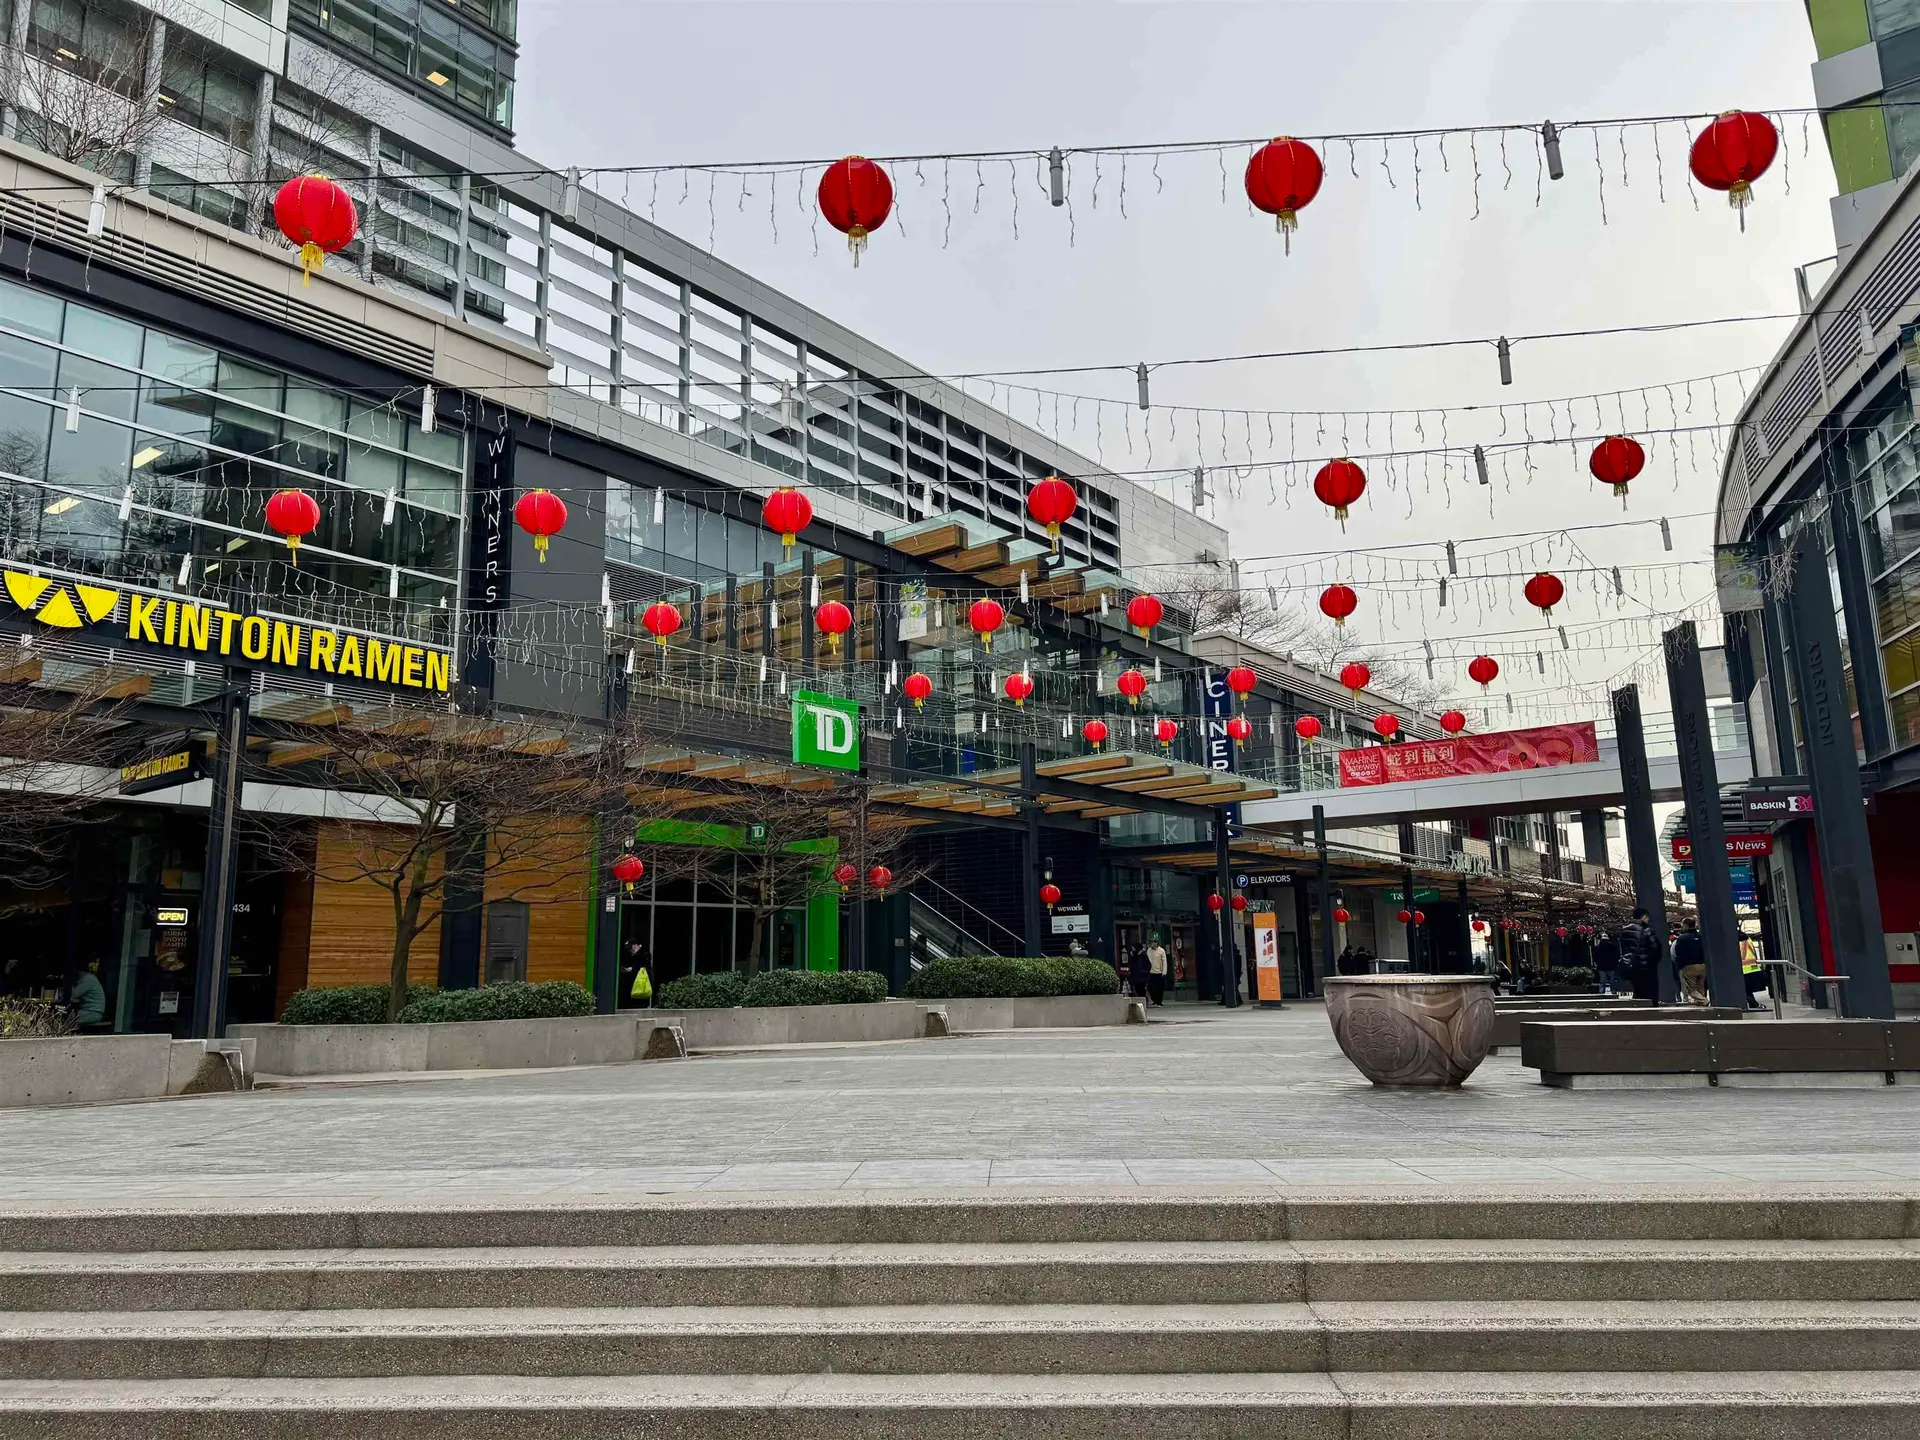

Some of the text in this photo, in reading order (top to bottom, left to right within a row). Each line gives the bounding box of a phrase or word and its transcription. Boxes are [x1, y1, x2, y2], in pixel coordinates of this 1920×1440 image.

[486, 436, 505, 602] WINNERS
[128, 594, 450, 692] KINTON RAMEN
[1806, 640, 1835, 747] INDUSTRY
[806, 704, 853, 755] TD
[1345, 755, 1379, 766] MARINE
[1386, 745, 1454, 766] 蛇到福到
[1750, 801, 1786, 810] BASKIN
[751, 825, 764, 838] TD
[1735, 841, 1767, 851] News
[1250, 875, 1291, 884] ELEVATORS
[232, 904, 251, 912] 434
[1057, 903, 1083, 912] wework
[158, 912, 184, 921] OPEN
